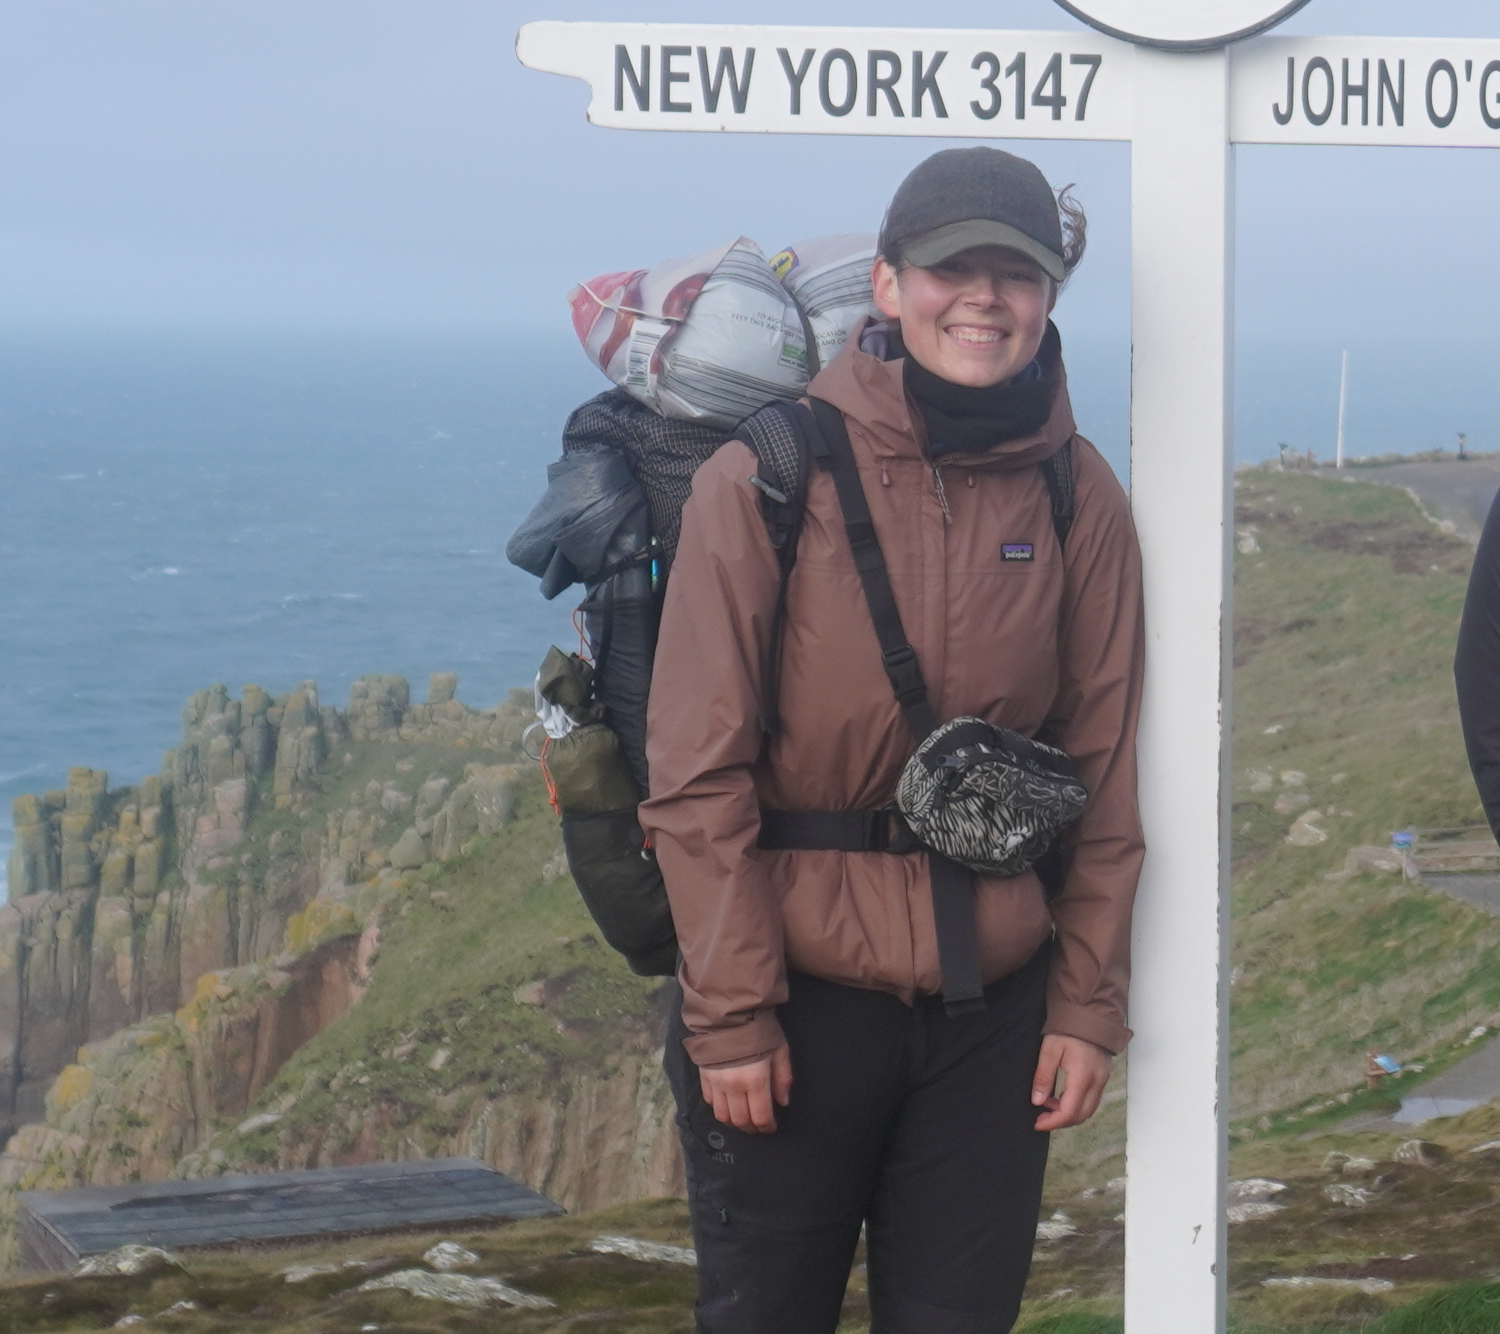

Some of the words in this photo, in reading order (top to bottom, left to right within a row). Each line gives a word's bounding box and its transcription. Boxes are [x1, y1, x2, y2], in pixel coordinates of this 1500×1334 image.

[614, 44, 756, 114] NEW
[776, 47, 949, 119] YORK
[969, 51, 1102, 122] 3147
[1272, 56, 1405, 127] JOHN
